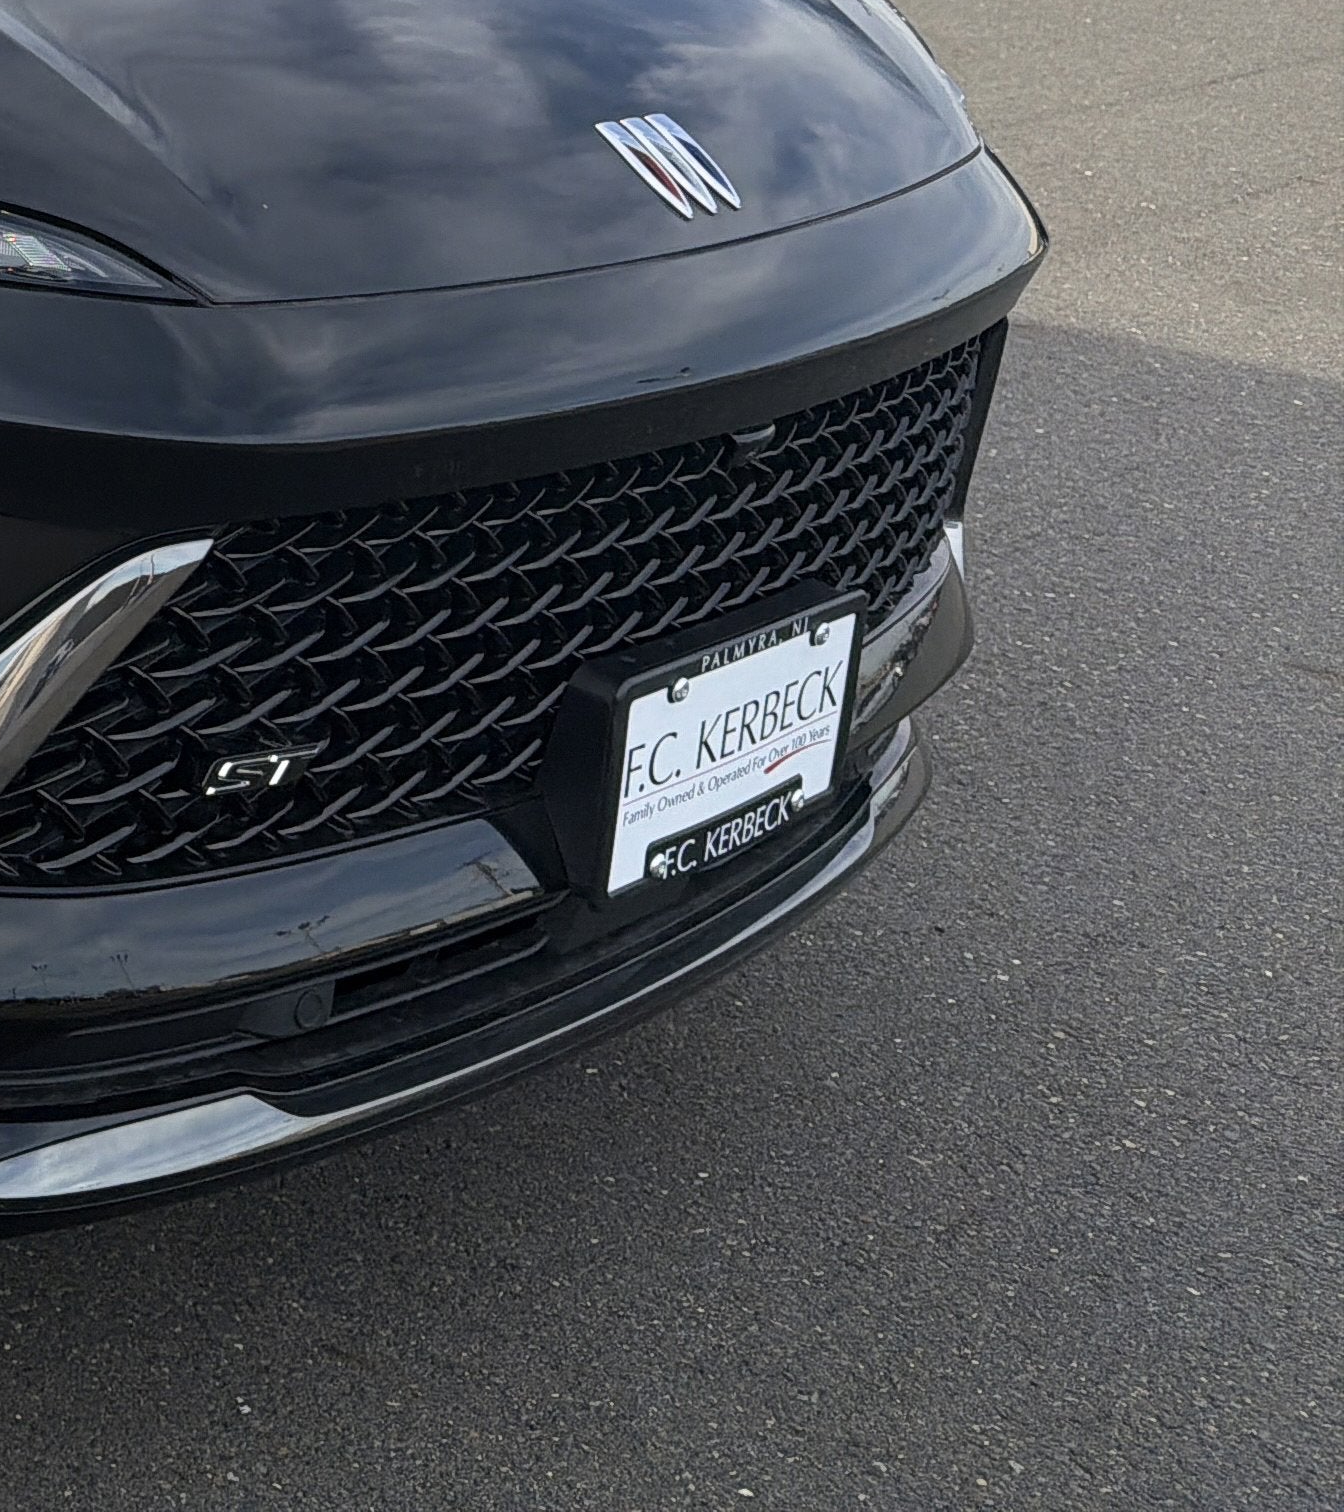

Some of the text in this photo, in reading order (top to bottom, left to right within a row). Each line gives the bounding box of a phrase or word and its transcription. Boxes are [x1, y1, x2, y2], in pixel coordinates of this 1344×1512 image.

[701, 629, 783, 673] PALMYRA,
[623, 724, 831, 827] Family Owned & Operated For Over 100 Years
[624, 660, 844, 798] F.C. KERBECK
[662, 791, 792, 880] F.C. KERBECK
